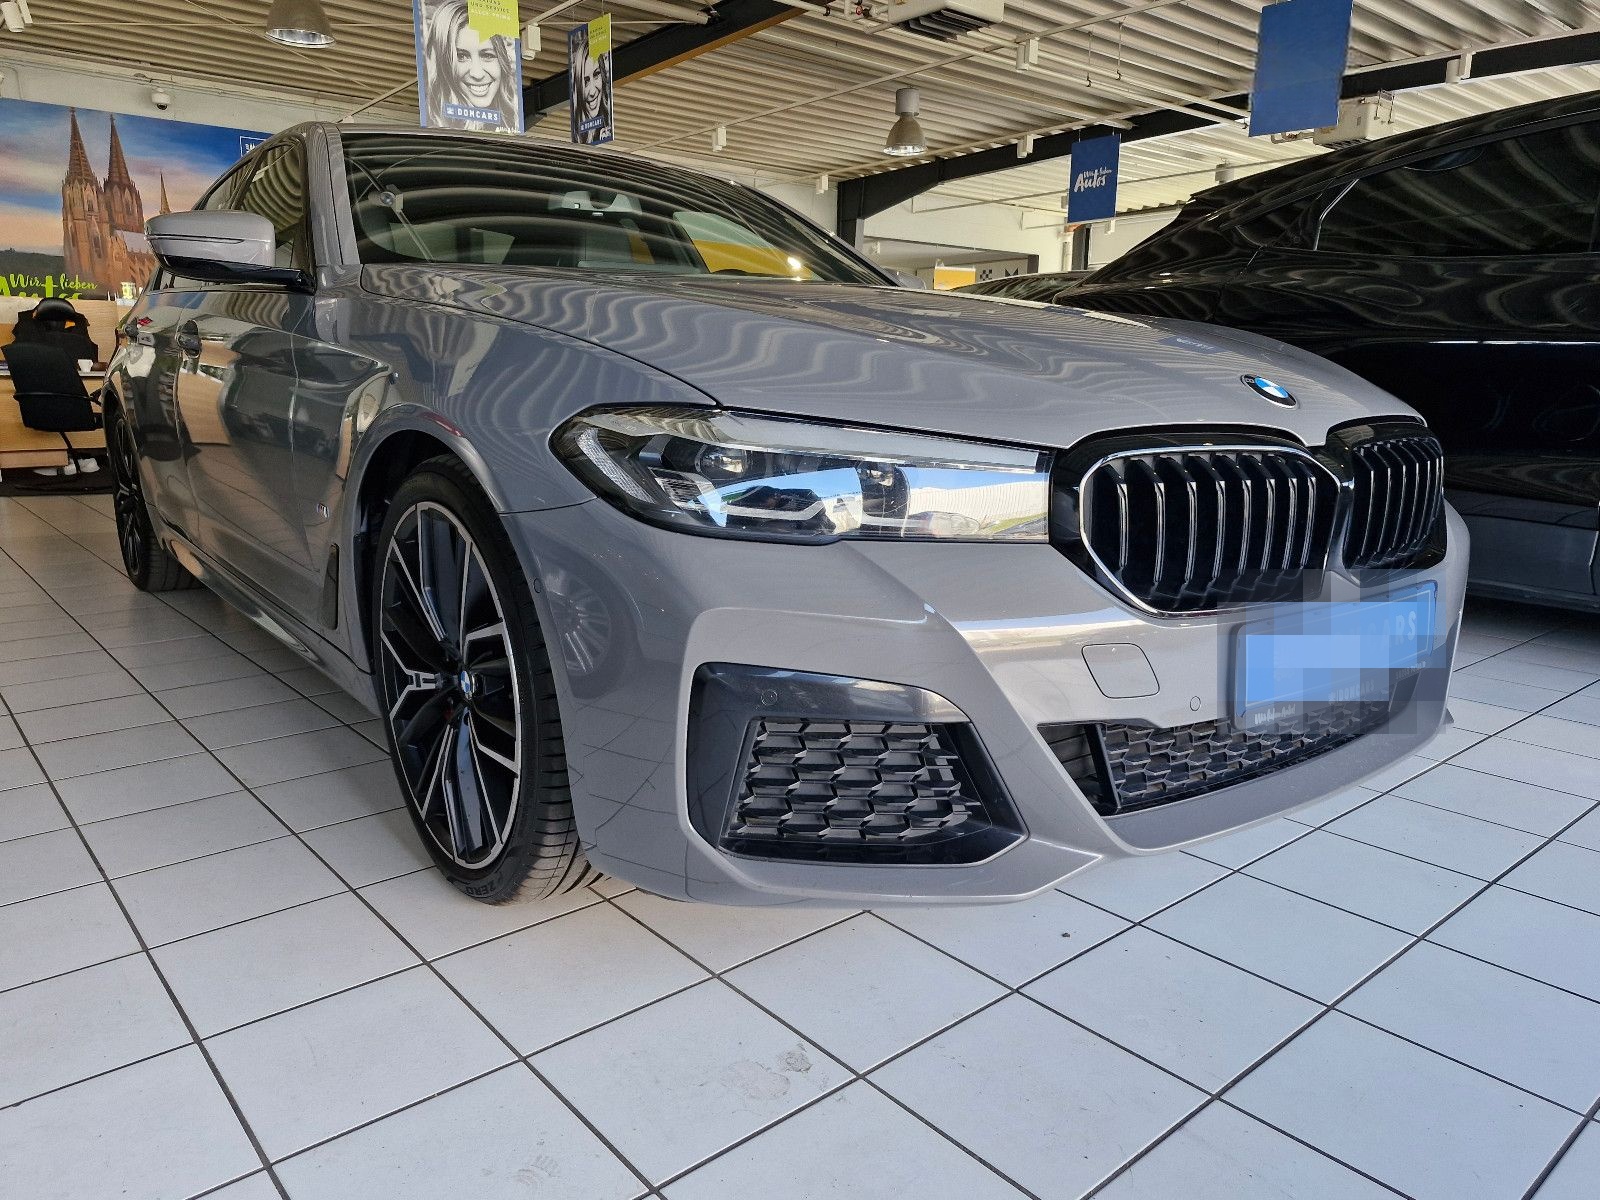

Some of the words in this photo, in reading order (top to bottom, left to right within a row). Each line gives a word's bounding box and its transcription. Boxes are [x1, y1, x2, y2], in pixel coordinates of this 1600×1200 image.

[457, 108, 498, 121] DOMCARS
[1074, 170, 1106, 192] Autos
[9, 273, 45, 288] Wir
[60, 273, 98, 290] lieben
